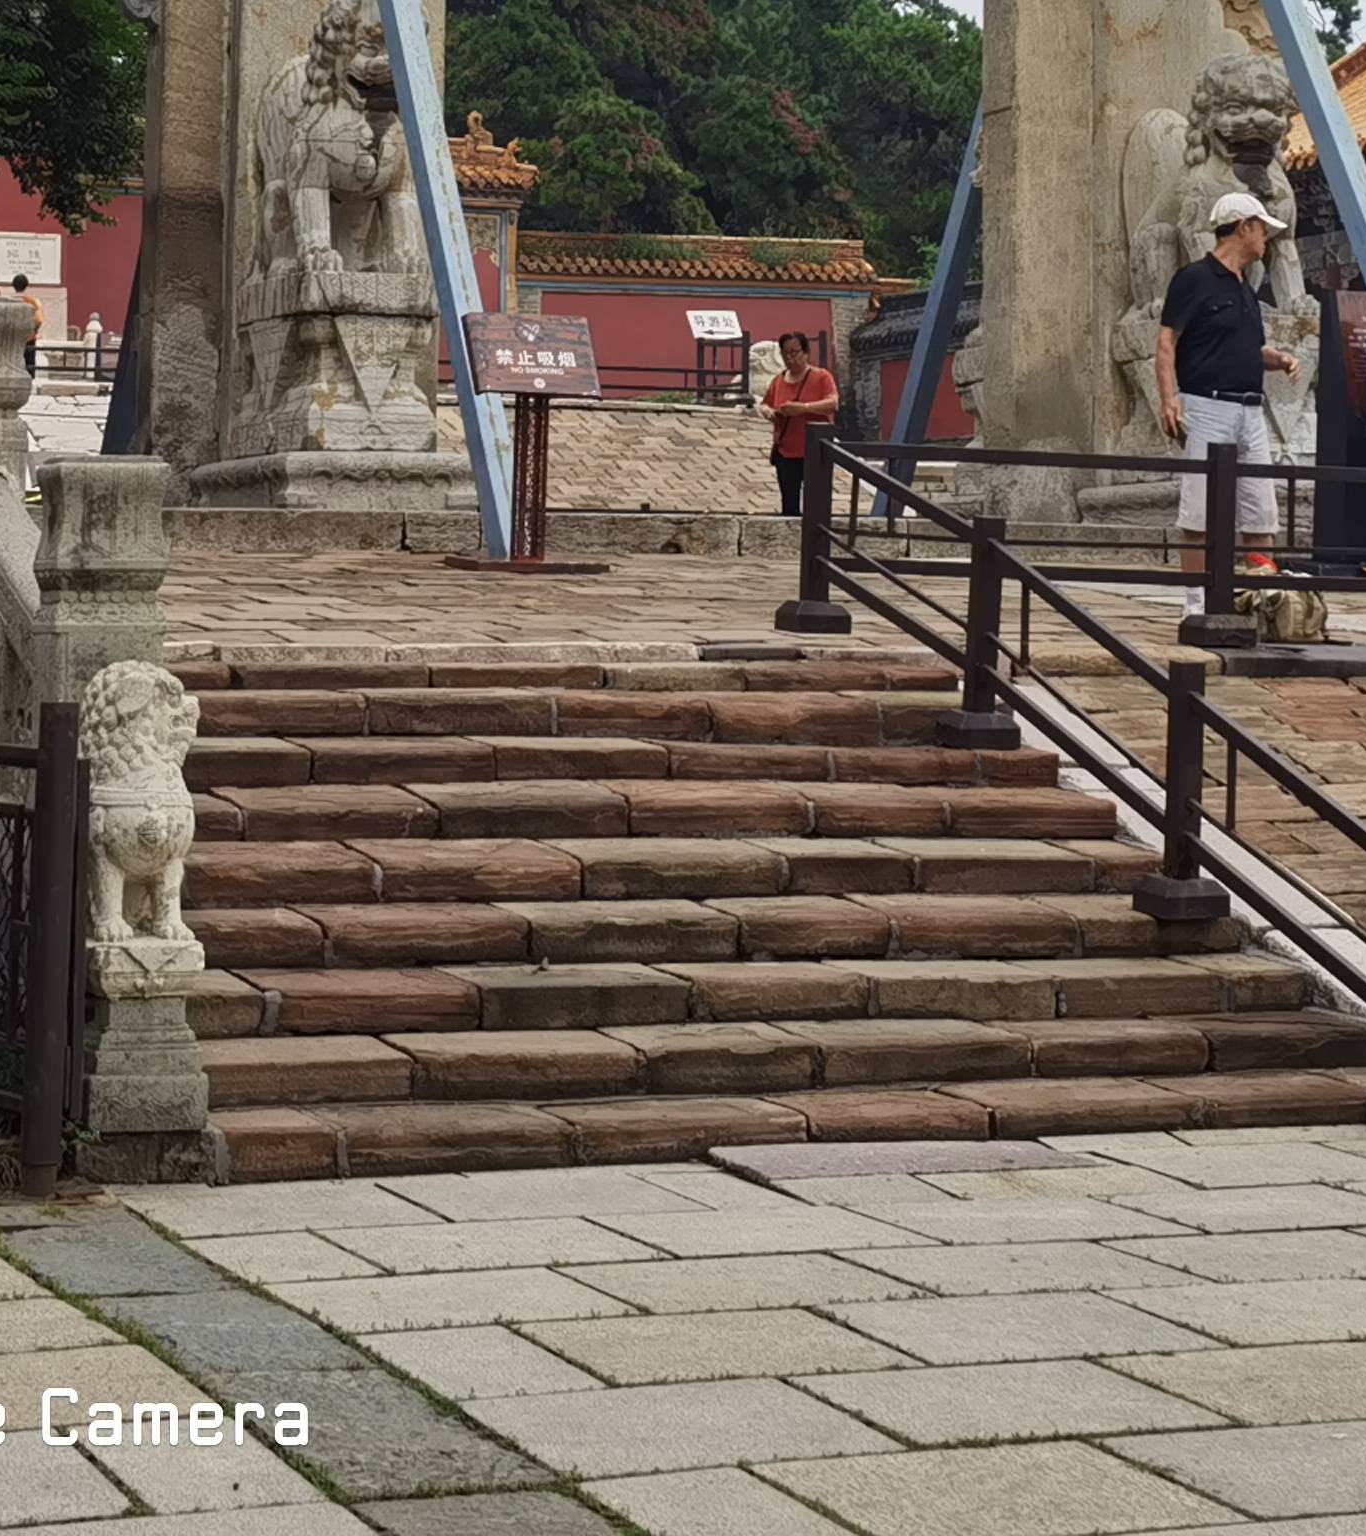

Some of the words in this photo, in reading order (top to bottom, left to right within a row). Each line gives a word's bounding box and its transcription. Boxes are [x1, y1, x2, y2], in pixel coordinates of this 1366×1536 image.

[495, 348, 577, 368] 禁止吸烟
[511, 366, 524, 374] NO
[525, 367, 565, 376] SMOKING
